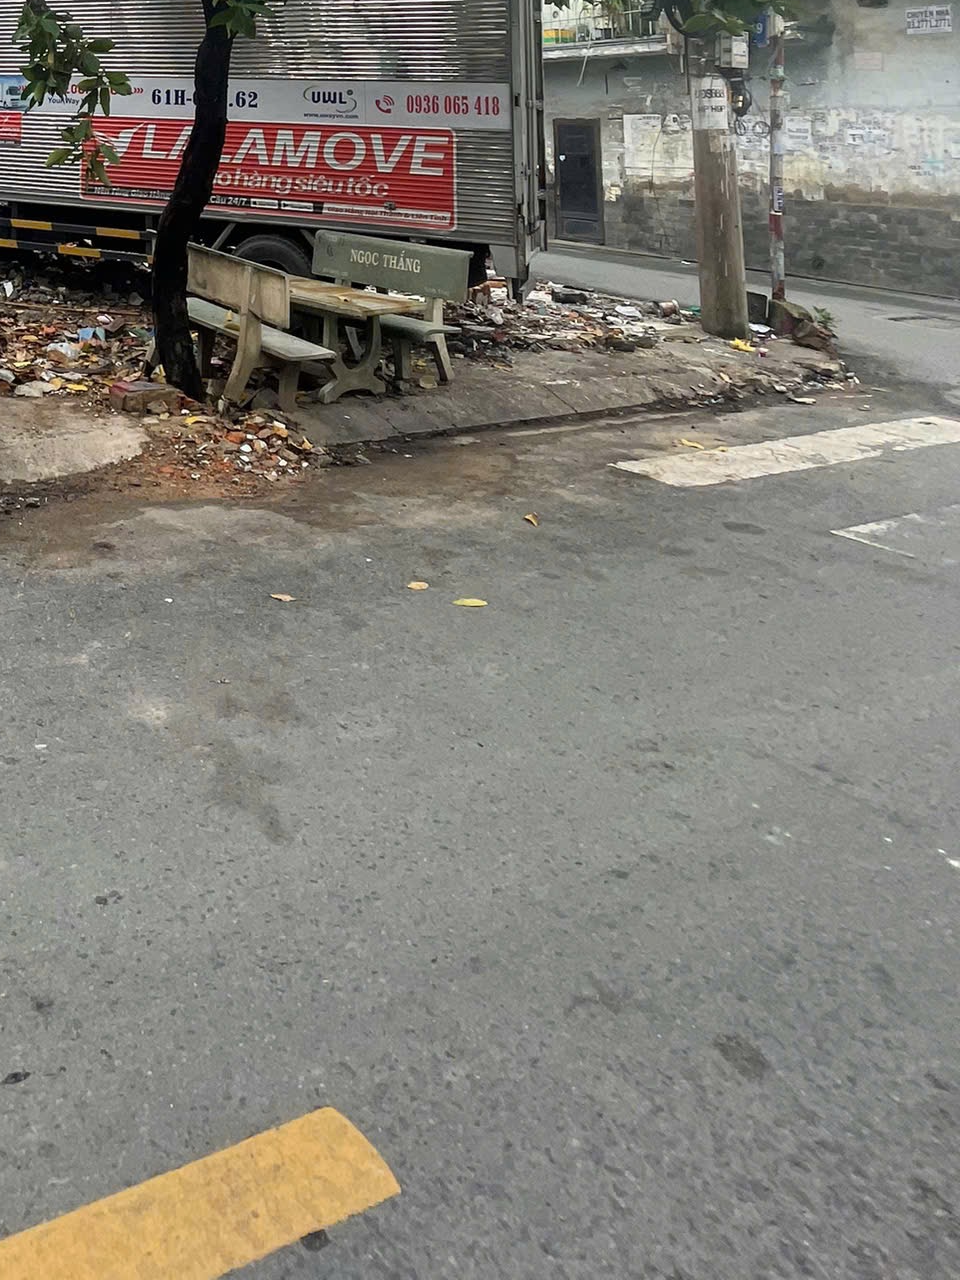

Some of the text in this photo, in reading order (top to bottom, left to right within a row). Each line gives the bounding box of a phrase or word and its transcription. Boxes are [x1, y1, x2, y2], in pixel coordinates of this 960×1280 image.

[151, 88, 258, 109] 61H-.62
[311, 90, 347, 105] UWL
[406, 94, 500, 116] 0936 065 418
[350, 249, 421, 273] NGỌC THẮNG
